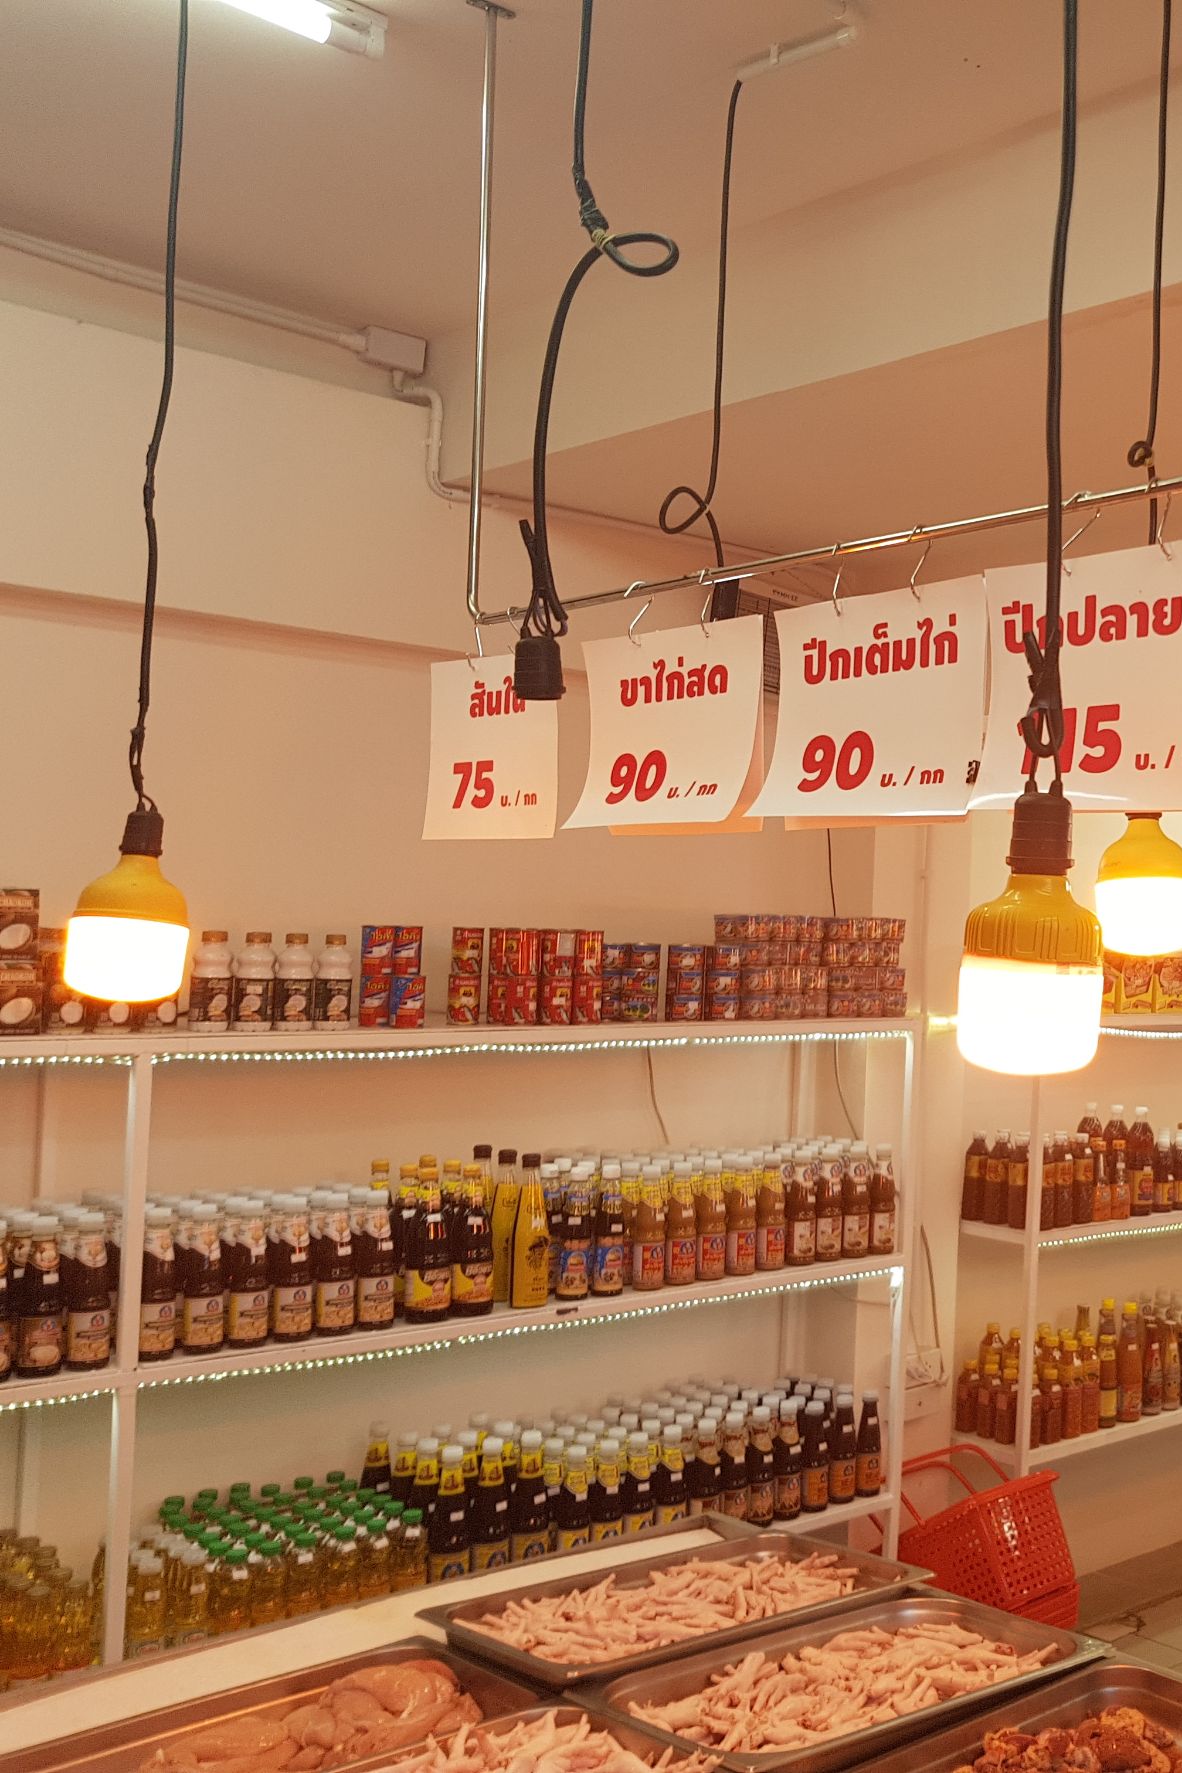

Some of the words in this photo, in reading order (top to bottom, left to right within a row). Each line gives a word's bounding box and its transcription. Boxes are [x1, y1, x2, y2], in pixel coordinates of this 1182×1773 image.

[802, 612, 959, 686] ปีกเต็มไก่
[619, 656, 729, 708] ขาไก่สด
[452, 760, 495, 809] 75
[605, 749, 667, 805] 90
[797, 730, 875, 793] 90
